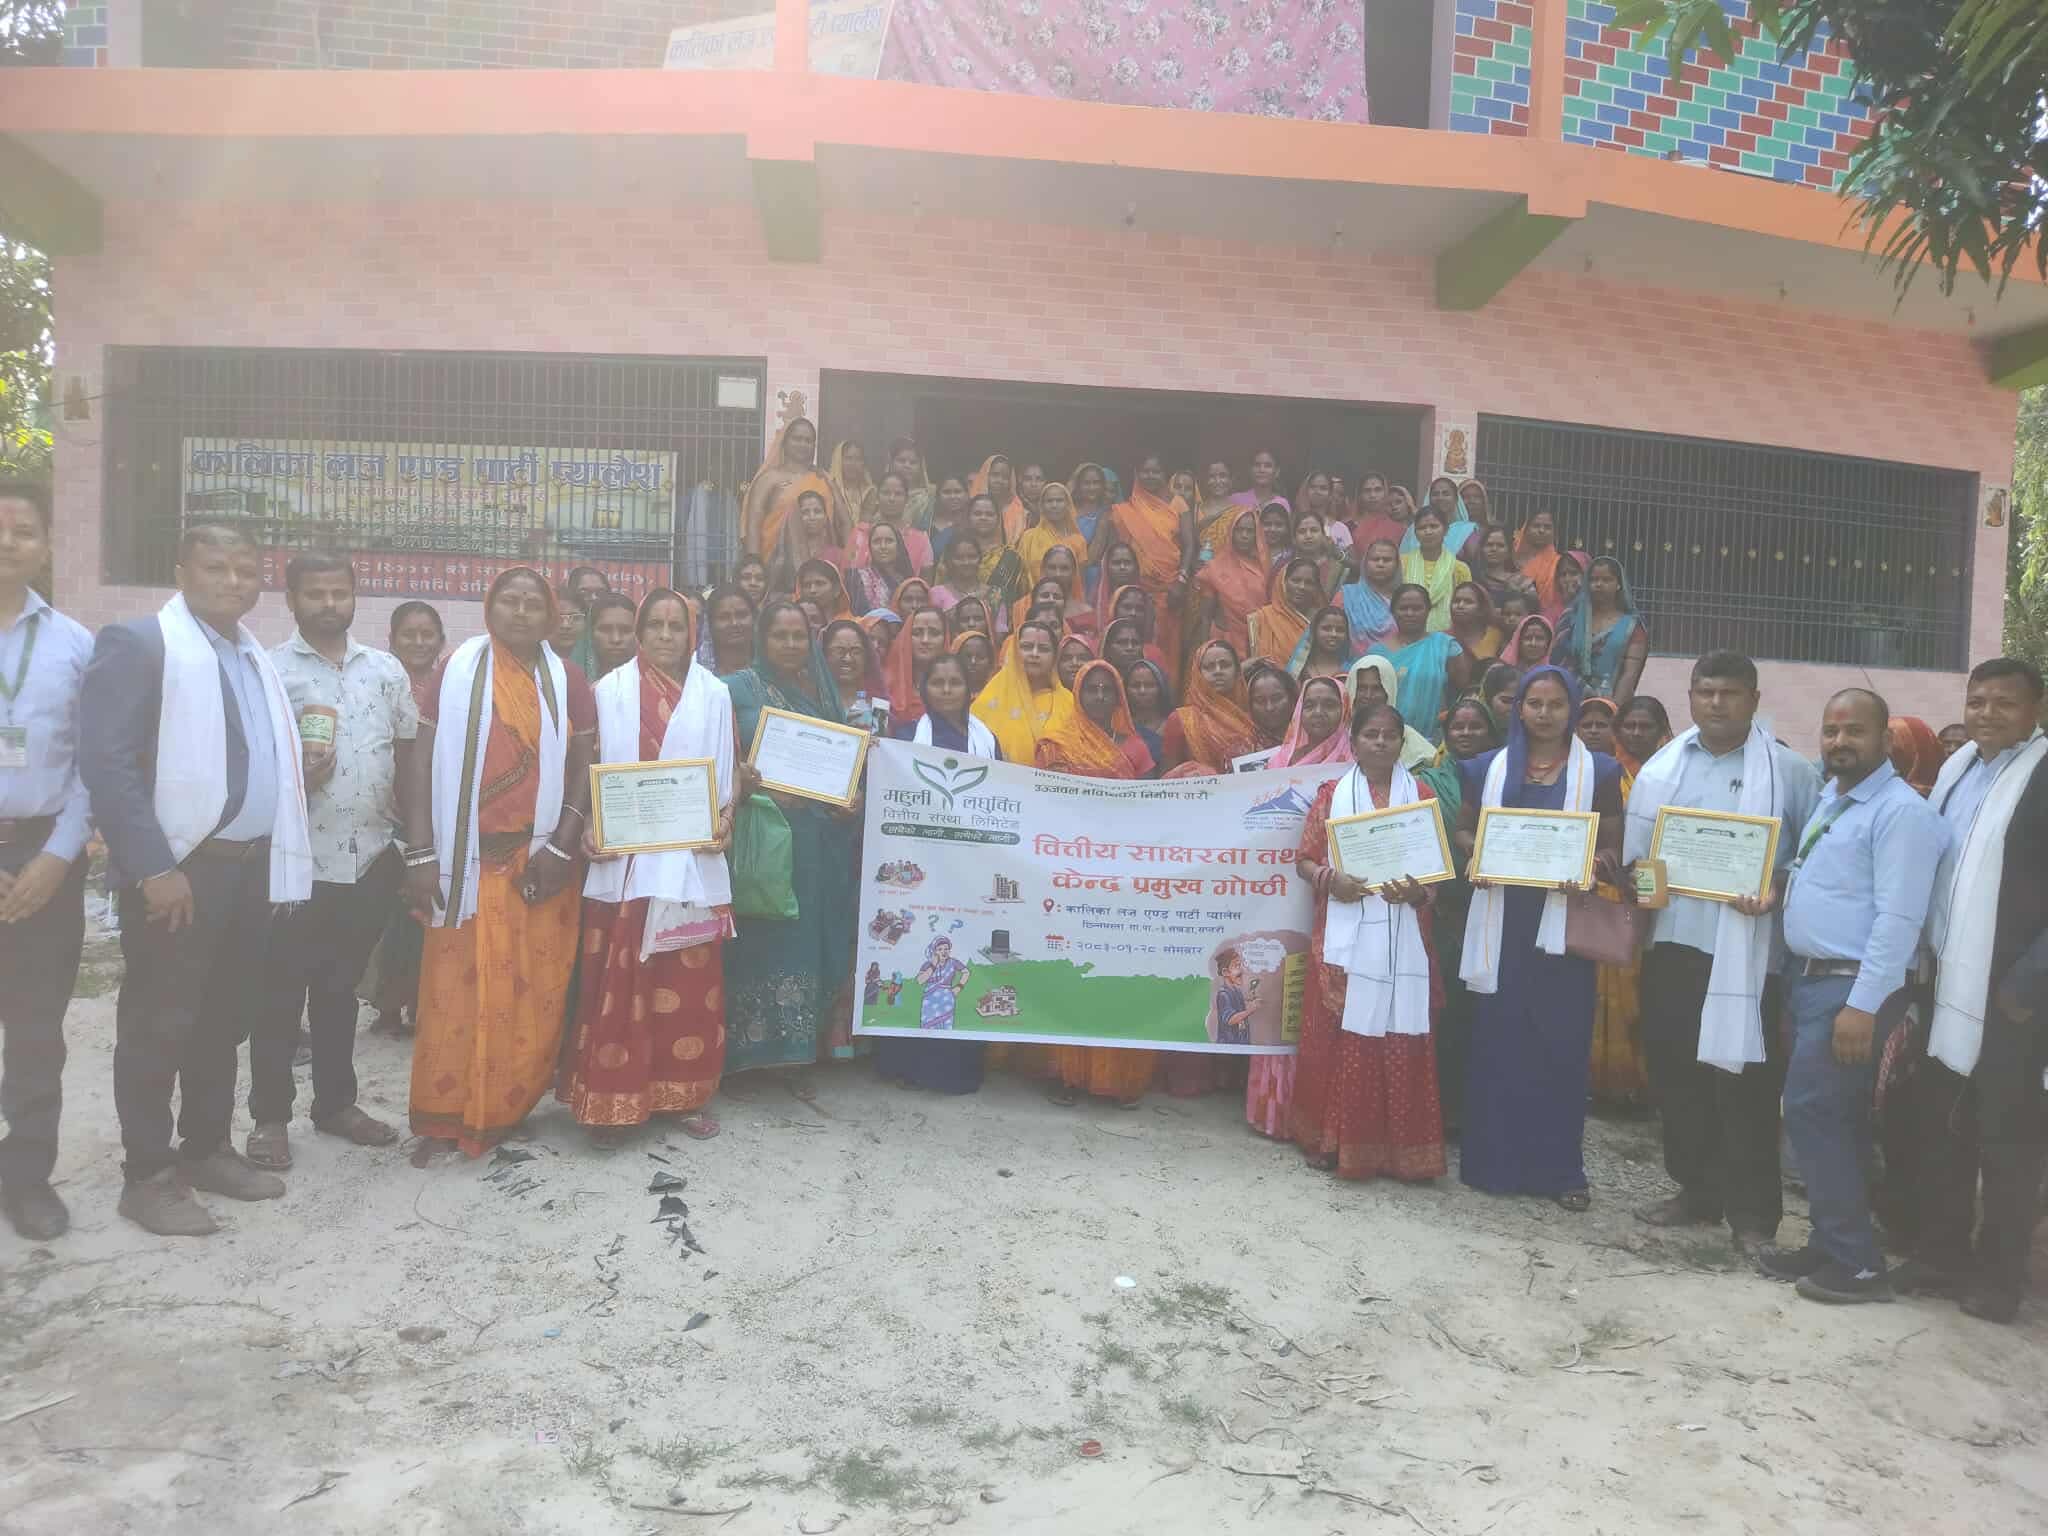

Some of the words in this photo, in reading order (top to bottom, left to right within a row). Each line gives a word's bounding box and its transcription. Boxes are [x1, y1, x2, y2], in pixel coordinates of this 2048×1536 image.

[193, 443, 314, 479] कालिका
[325, 452, 391, 482] लज
[398, 455, 465, 484] एण्ड
[475, 446, 541, 486] पार्टी
[883, 789, 931, 806] महुली
[963, 795, 1023, 814] लघुवित्त
[882, 806, 920, 821] वित्तीय
[928, 811, 961, 825] संस्था
[970, 815, 1020, 830] लिमिटेड
[1032, 833, 1120, 860] वित्तीय
[1124, 844, 1248, 864] साक्षरता
[1131, 876, 1205, 899] प्रमुख
[1211, 873, 1288, 897] गोष्ठी
[1066, 904, 1111, 916] कालिका
[1117, 906, 1136, 917] लज
[1144, 909, 1169, 920] एण्ड
[1176, 907, 1200, 920] पार्टी
[1206, 909, 1241, 921] प्यालेस
